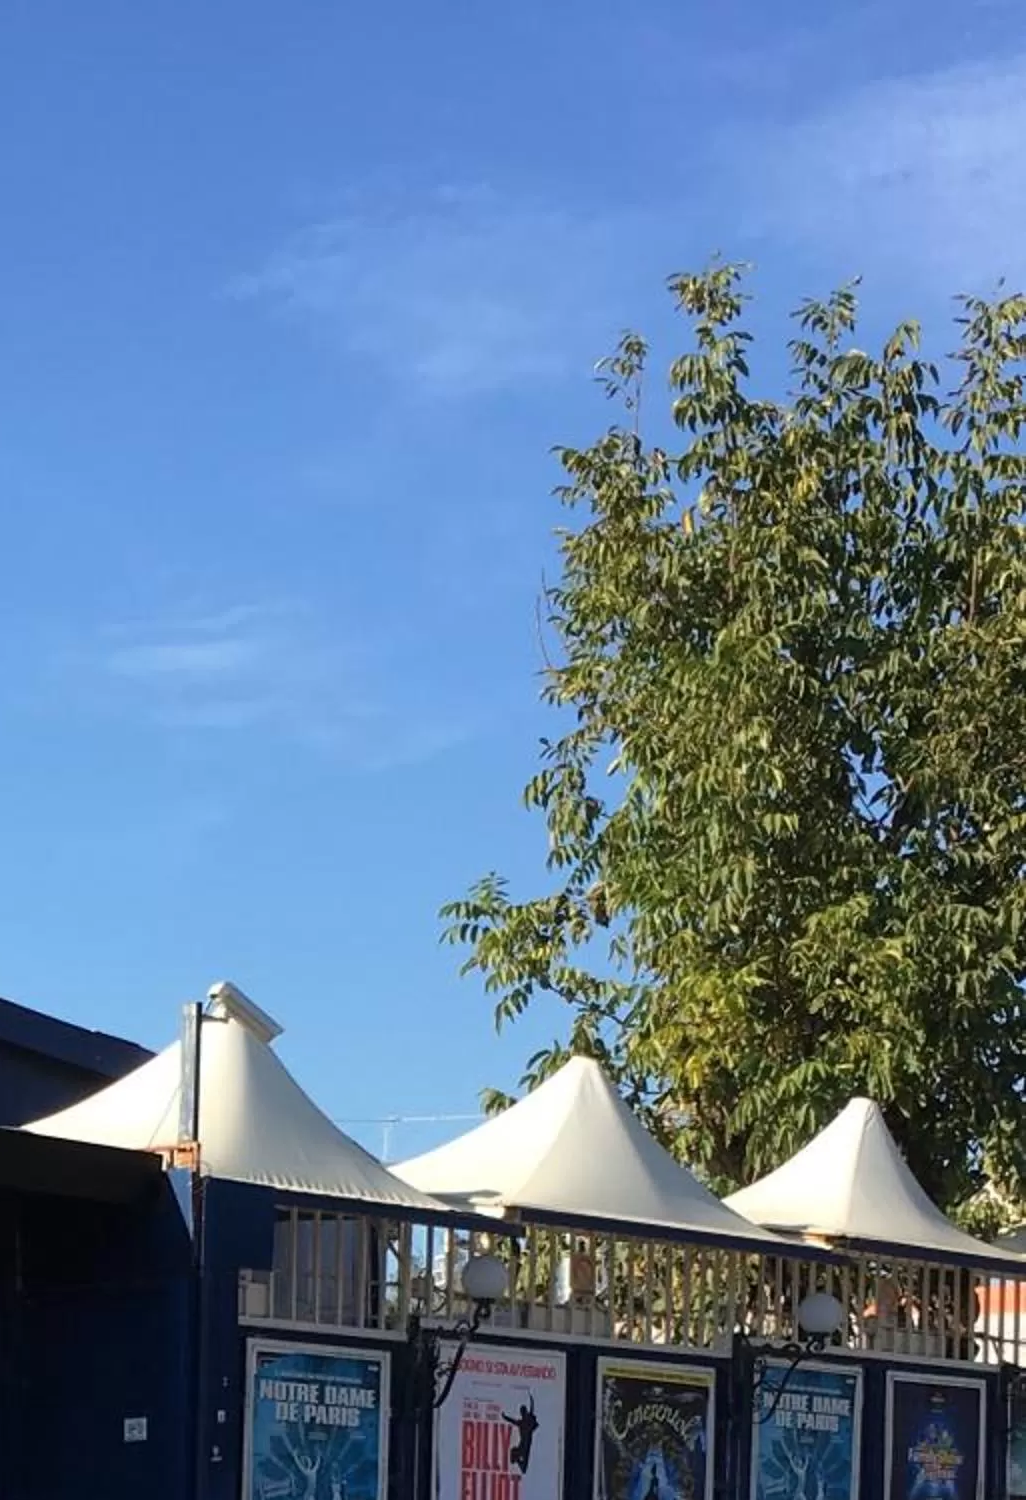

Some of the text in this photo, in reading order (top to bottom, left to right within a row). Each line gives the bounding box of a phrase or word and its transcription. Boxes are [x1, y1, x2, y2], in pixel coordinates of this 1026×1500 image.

[260, 1379, 377, 1410] NOTRE DAME
[813, 1395, 851, 1417] DAME
[276, 1402, 361, 1428] DE PARIS
[776, 1409, 839, 1433] DE PARIS
[462, 1419, 513, 1473] BILLY
